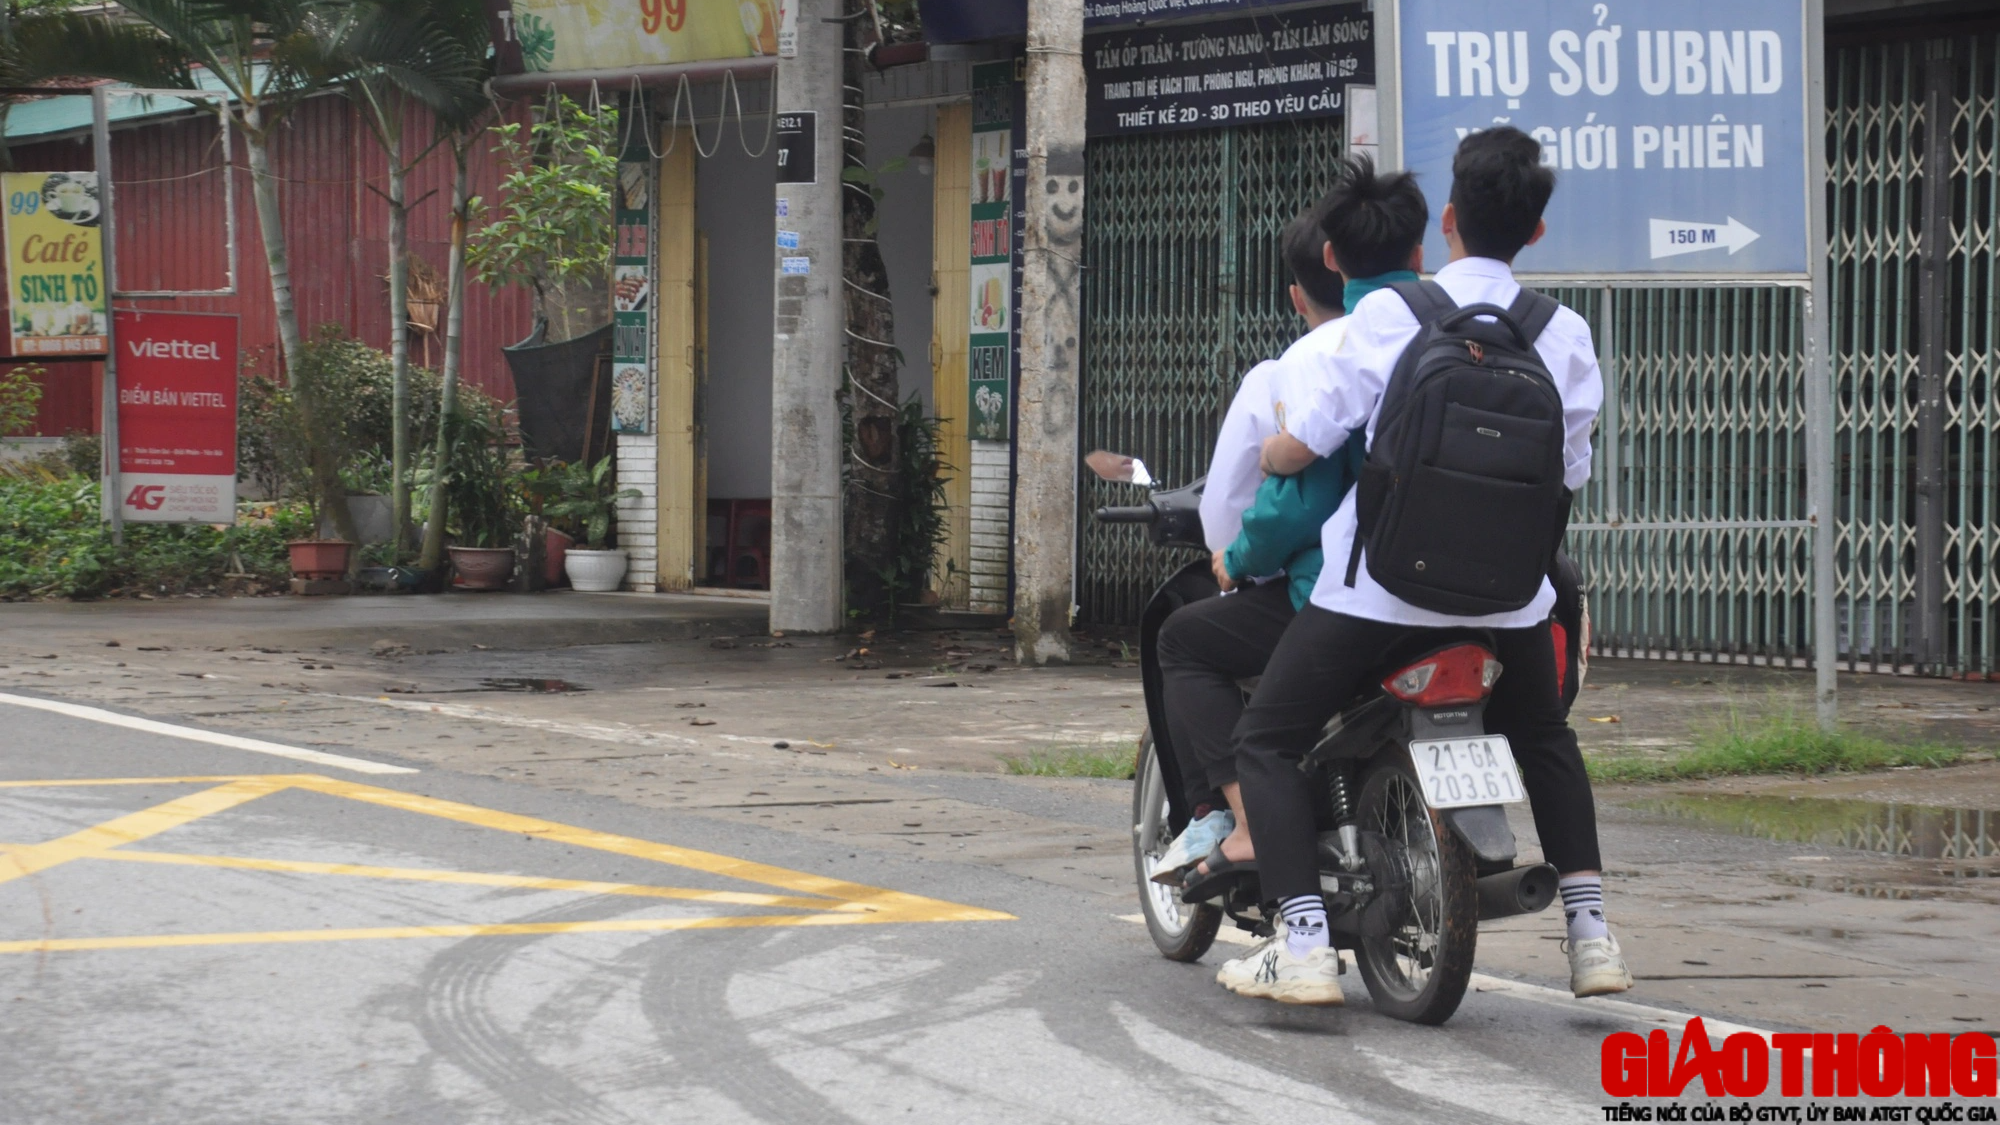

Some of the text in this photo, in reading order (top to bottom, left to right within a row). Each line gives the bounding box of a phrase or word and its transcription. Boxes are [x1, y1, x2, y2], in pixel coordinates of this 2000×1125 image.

[1095, 2, 1120, 17] Đường
[1121, 0, 1147, 15] Hoàng
[1095, 39, 1120, 69] TẤM
[1122, 38, 1138, 66] ỐP
[1141, 34, 1174, 65] TRẦN
[1181, 33, 1225, 61] TƯỜNG
[1227, 33, 1263, 56] NANO
[1272, 19, 1300, 51] TẤM
[1303, 20, 1331, 47] LÀM
[1333, 16, 1369, 44] SÓNG
[1426, 3, 1783, 109] TRỤ SỞ UBND
[1104, 82, 1131, 100] TRANG
[1133, 77, 1146, 98] TRÍ
[1147, 75, 1158, 100] HỆ
[1160, 74, 1182, 95] VÁCH
[1183, 75, 1202, 93] TIVI,
[1203, 69, 1233, 91] PHÒNG
[1235, 62, 1256, 88] NGỦ,
[1257, 63, 1289, 86] PHÒNG
[1290, 59, 1323, 82] KHÁCH,
[1325, 52, 1338, 78] TỦ
[1117, 105, 1156, 128] THIẾT
[1158, 102, 1178, 124] KẾ
[1179, 107, 1199, 123] 2D
[1210, 104, 1230, 120] 3D
[1232, 100, 1271, 118] THEO
[1275, 93, 1304, 115] YÊU
[1308, 86, 1341, 111] CẦU
[1531, 112, 1618, 170] GIỚI
[1634, 113, 1764, 169] PHIÊN
[9, 190, 39, 215] 99
[22, 231, 89, 264] Café
[973, 204, 1010, 258] SINH TỐ
[1668, 229, 1716, 244] 150 M
[20, 260, 98, 303] SINH TỐ
[128, 337, 221, 360] viettel
[972, 346, 1005, 381] KEM
[120, 382, 227, 407] ĐIỂM BÁN VIETTEL
[125, 484, 166, 510] 4G
[1428, 741, 1499, 771] 21-GA
[1429, 771, 1515, 803] 203.61
